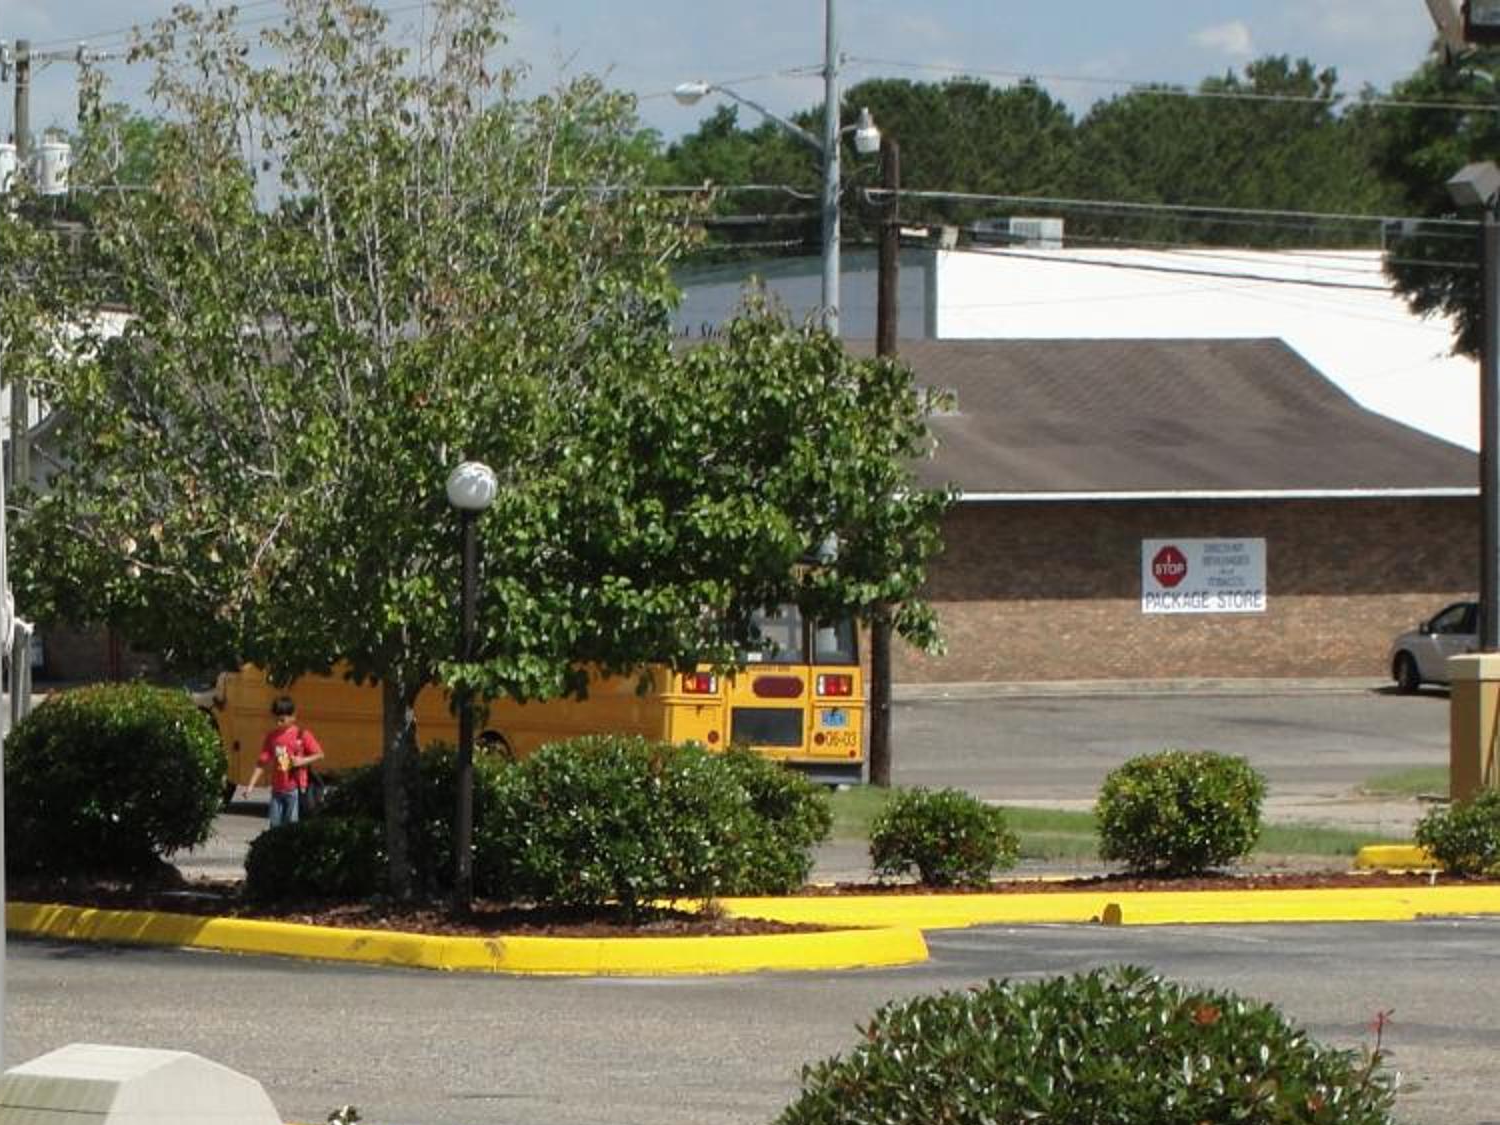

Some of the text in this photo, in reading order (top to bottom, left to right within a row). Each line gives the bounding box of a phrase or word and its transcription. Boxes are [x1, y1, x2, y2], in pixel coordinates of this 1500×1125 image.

[1155, 563, 1184, 575] STOP
[1145, 590, 1262, 610] PACKAGE STORE
